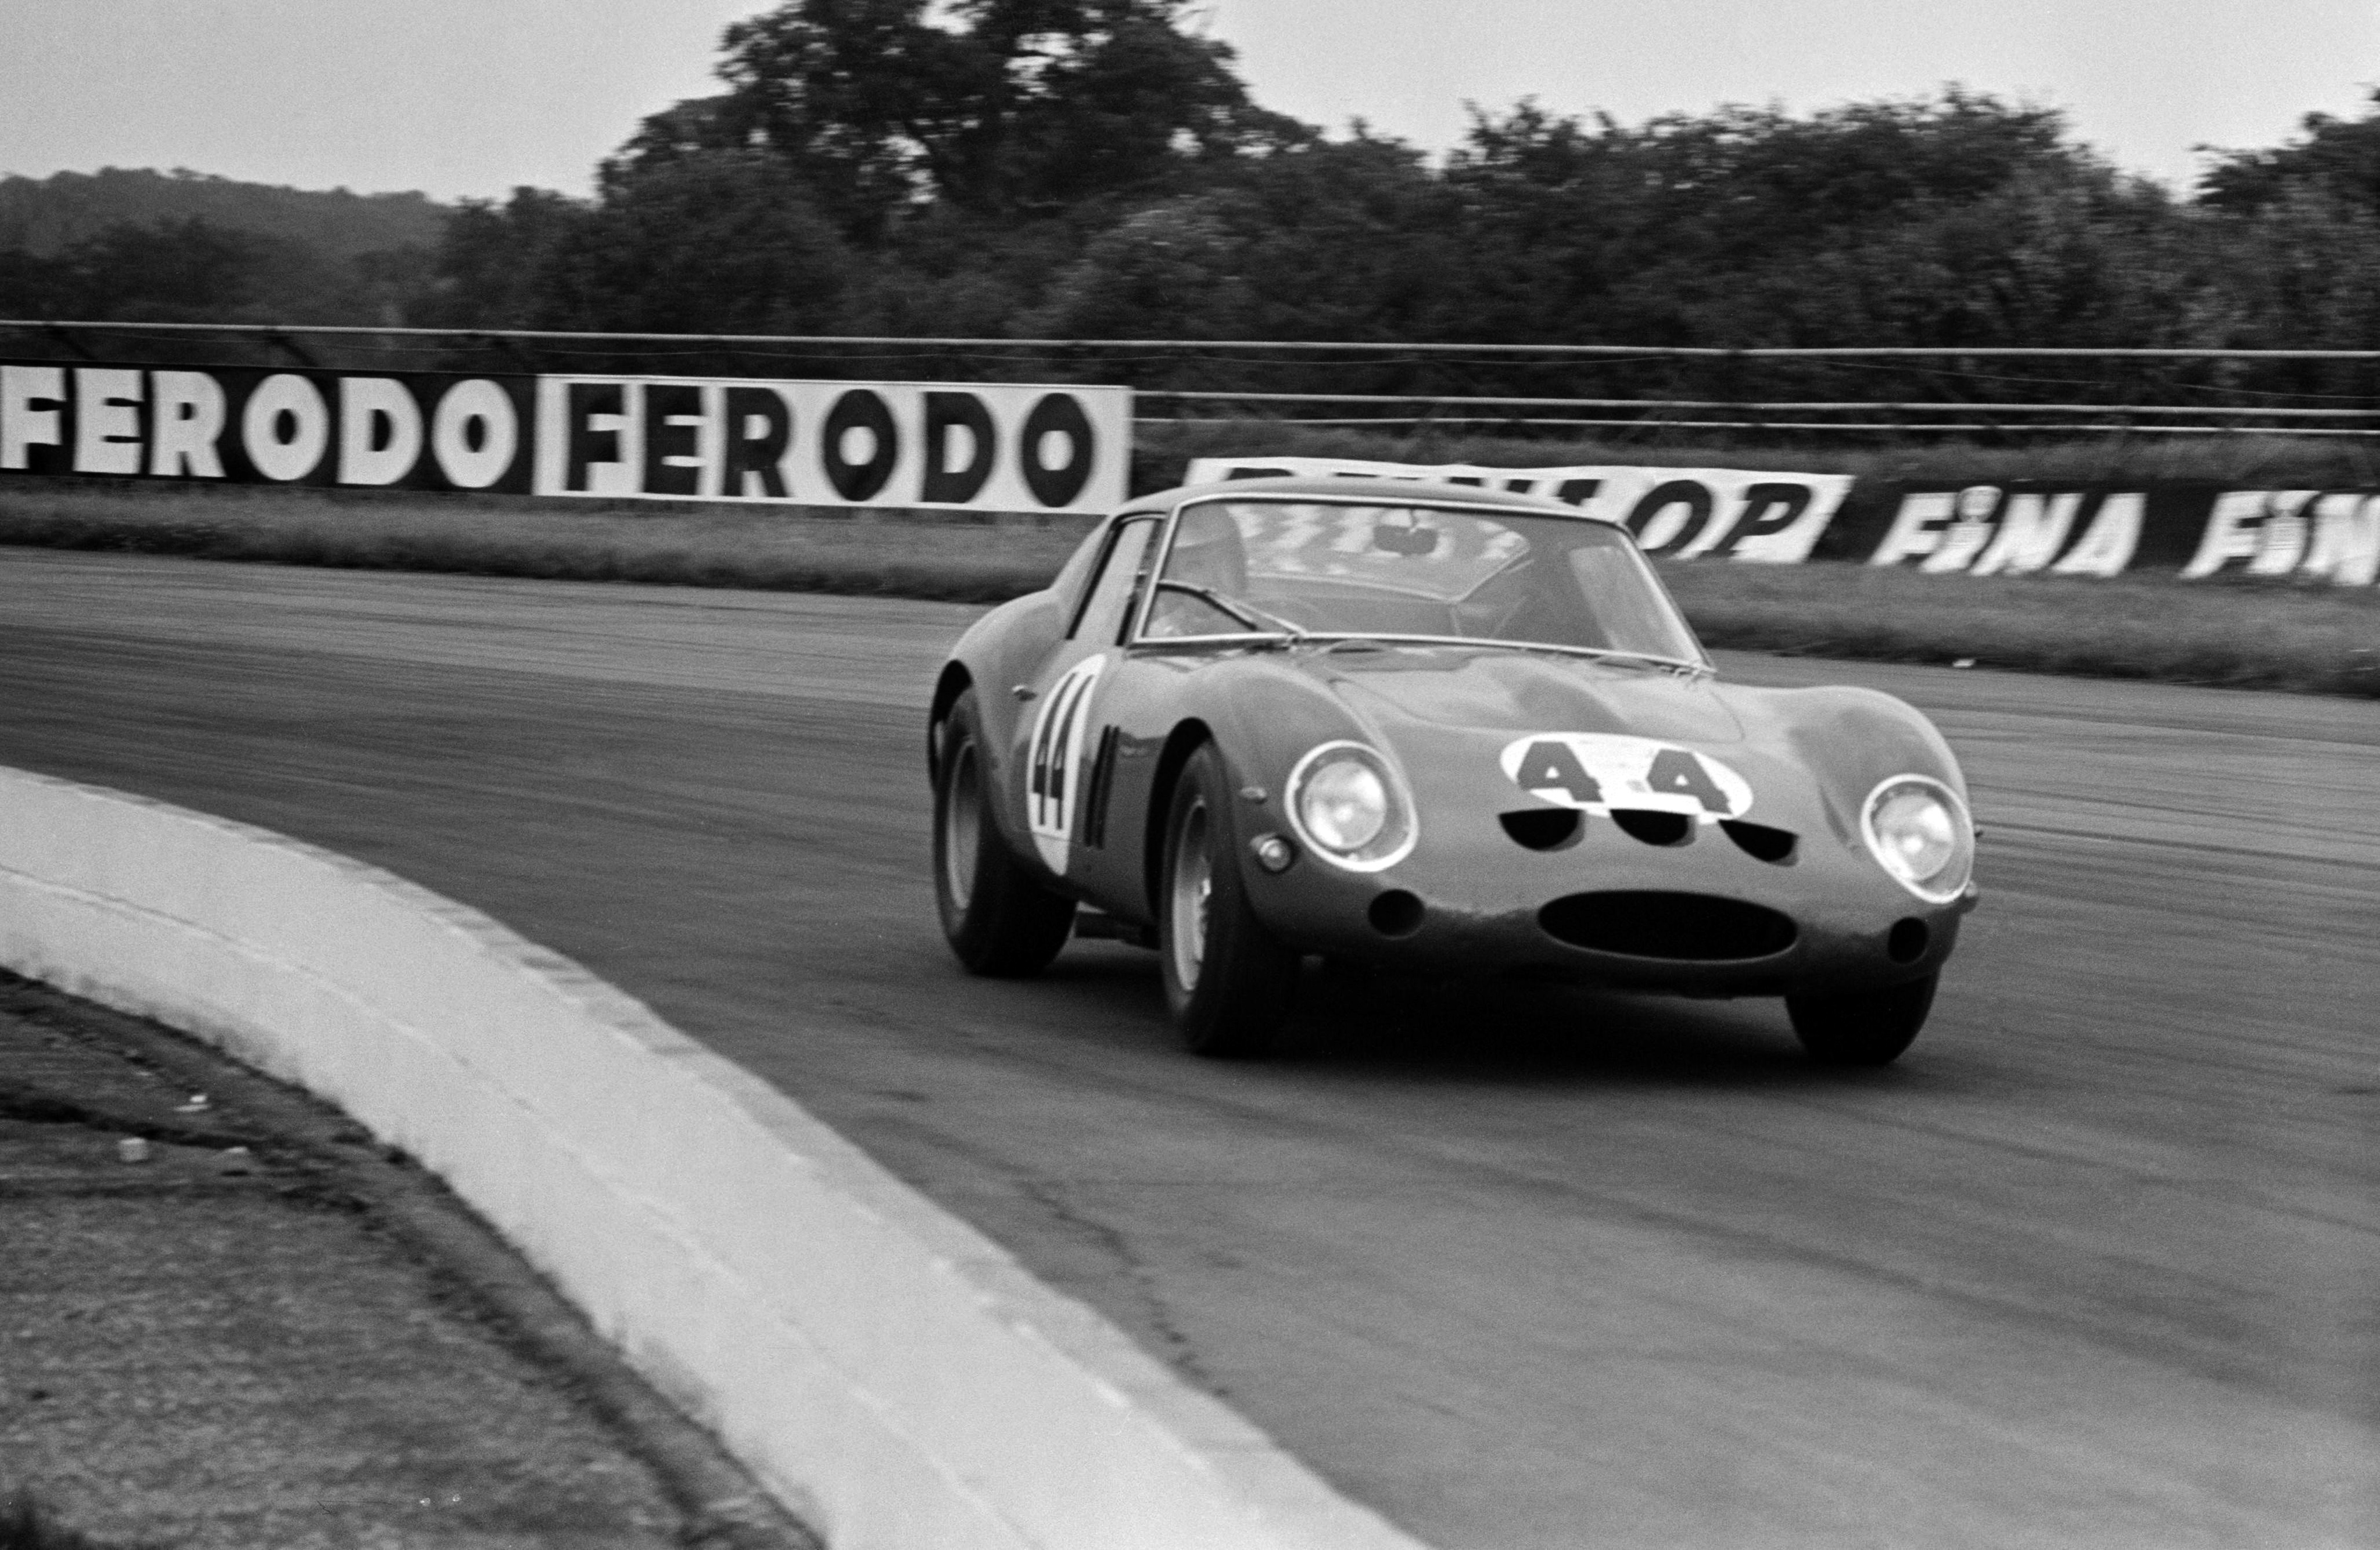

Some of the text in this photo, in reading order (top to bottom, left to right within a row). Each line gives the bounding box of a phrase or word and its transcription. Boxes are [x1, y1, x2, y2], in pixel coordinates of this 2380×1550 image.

[0, 365, 519, 488] FERODO
[562, 382, 1094, 509] FERODO
[1517, 741, 1733, 815] 44
